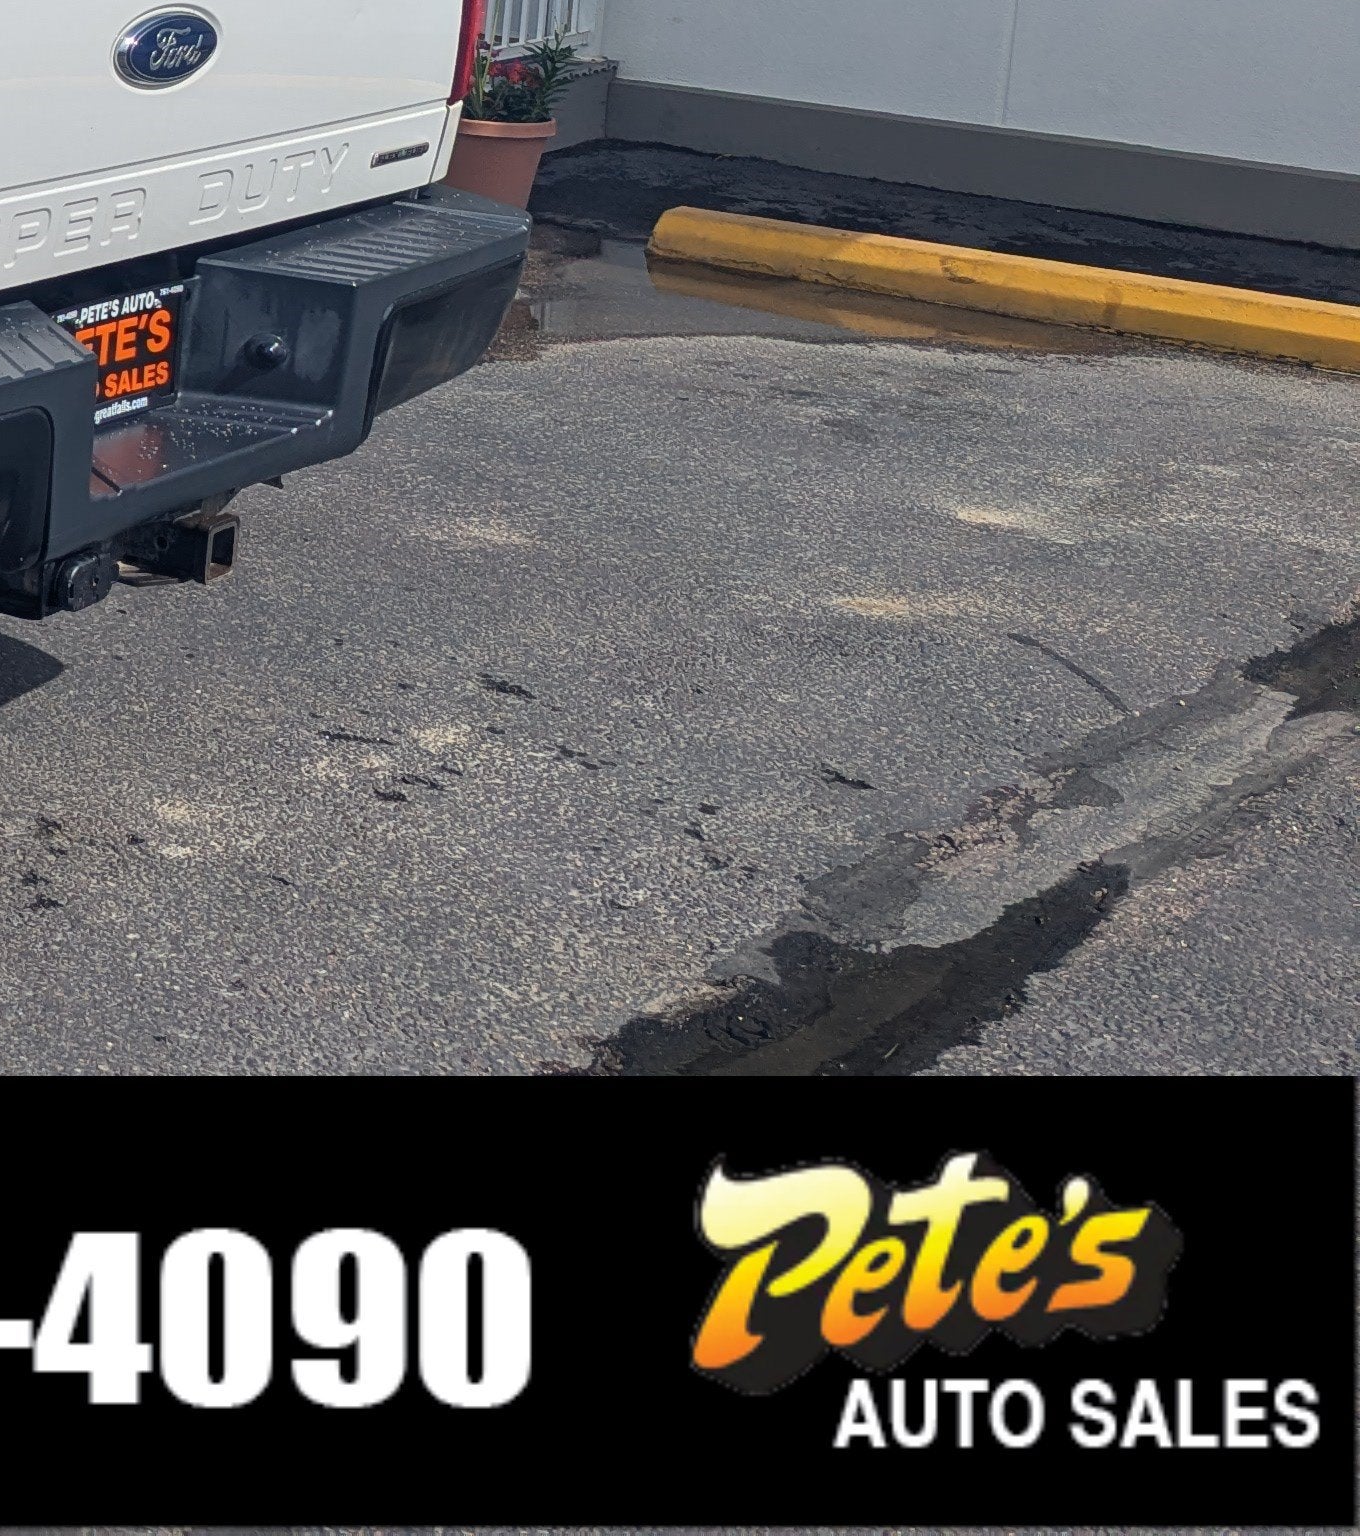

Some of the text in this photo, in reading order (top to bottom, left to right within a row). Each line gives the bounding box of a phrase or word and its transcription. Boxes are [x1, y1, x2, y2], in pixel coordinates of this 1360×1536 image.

[150, 26, 203, 70] Ford
[188, 142, 350, 227] DUTY
[80, 291, 155, 325] PETE'S AUTO
[75, 309, 171, 366] ETE'S
[105, 361, 170, 398] SALES
